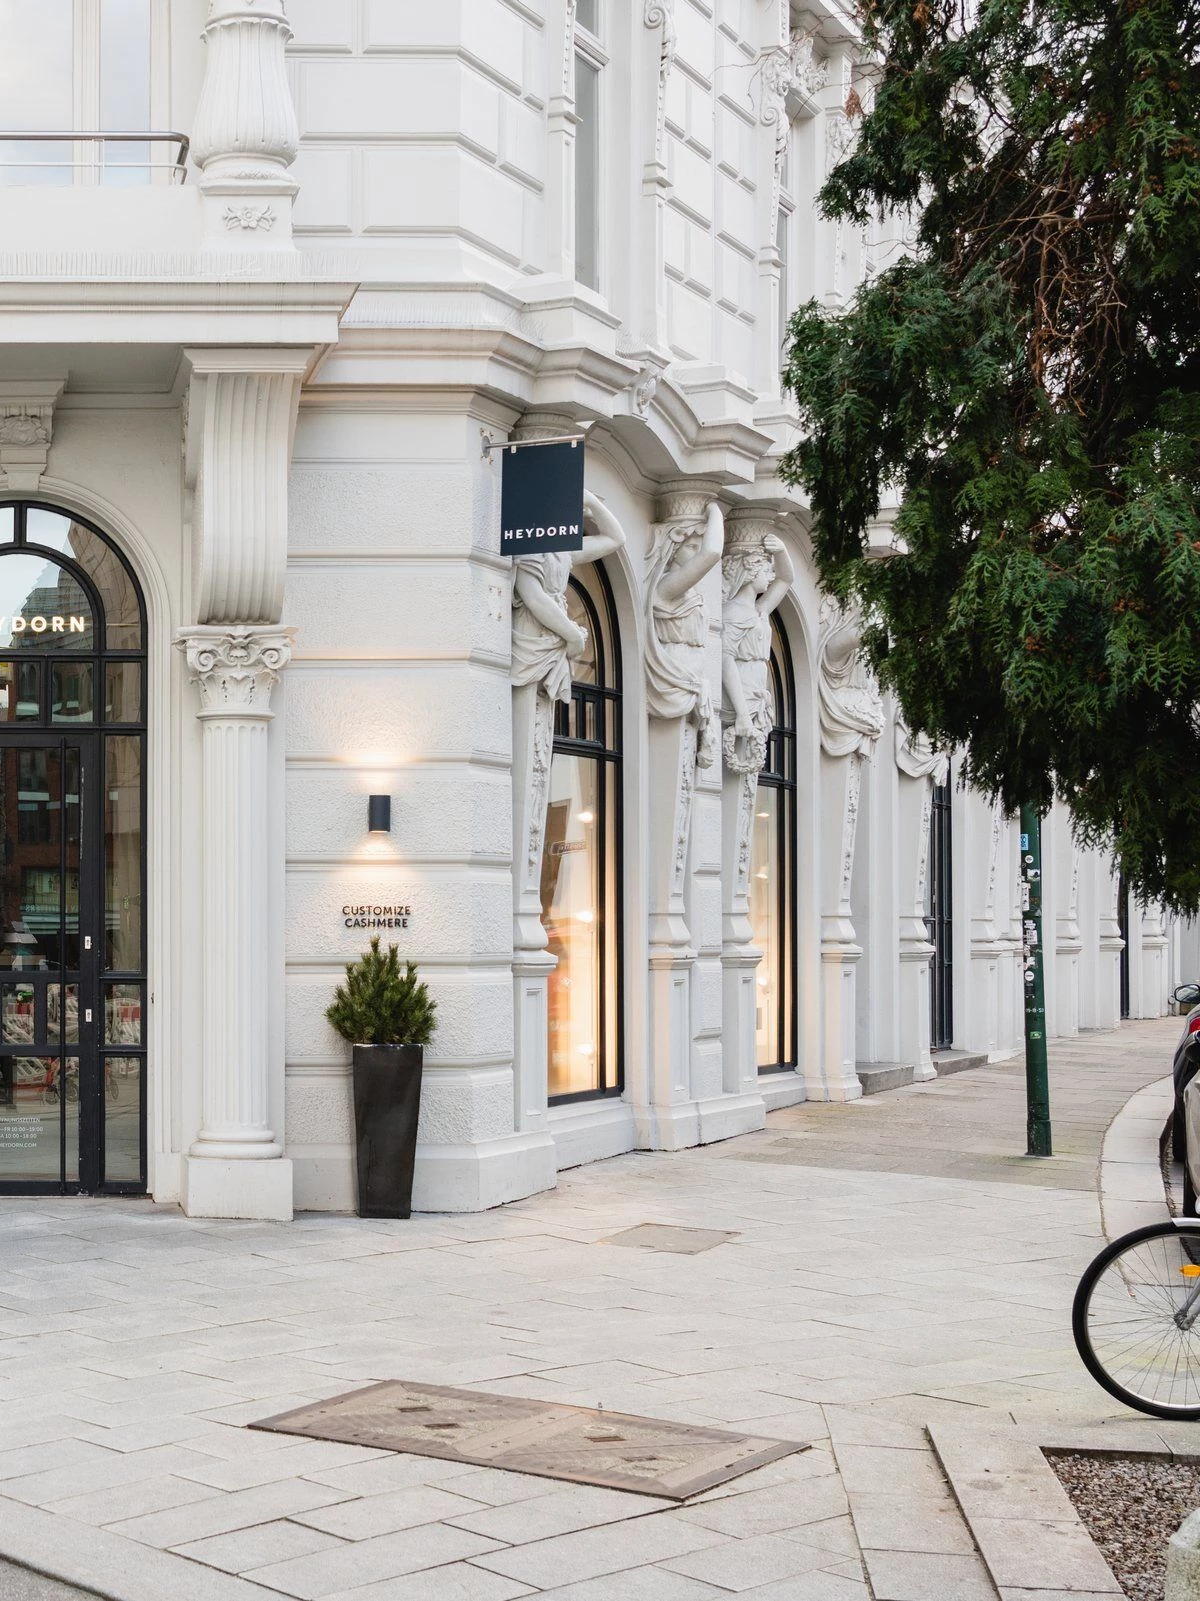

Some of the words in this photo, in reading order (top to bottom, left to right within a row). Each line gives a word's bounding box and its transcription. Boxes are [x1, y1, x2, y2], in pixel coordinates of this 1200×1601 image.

[504, 524, 579, 540] HEYDORN
[342, 905, 411, 916] CUSTOMIZE
[344, 918, 408, 928] CASHMERE
